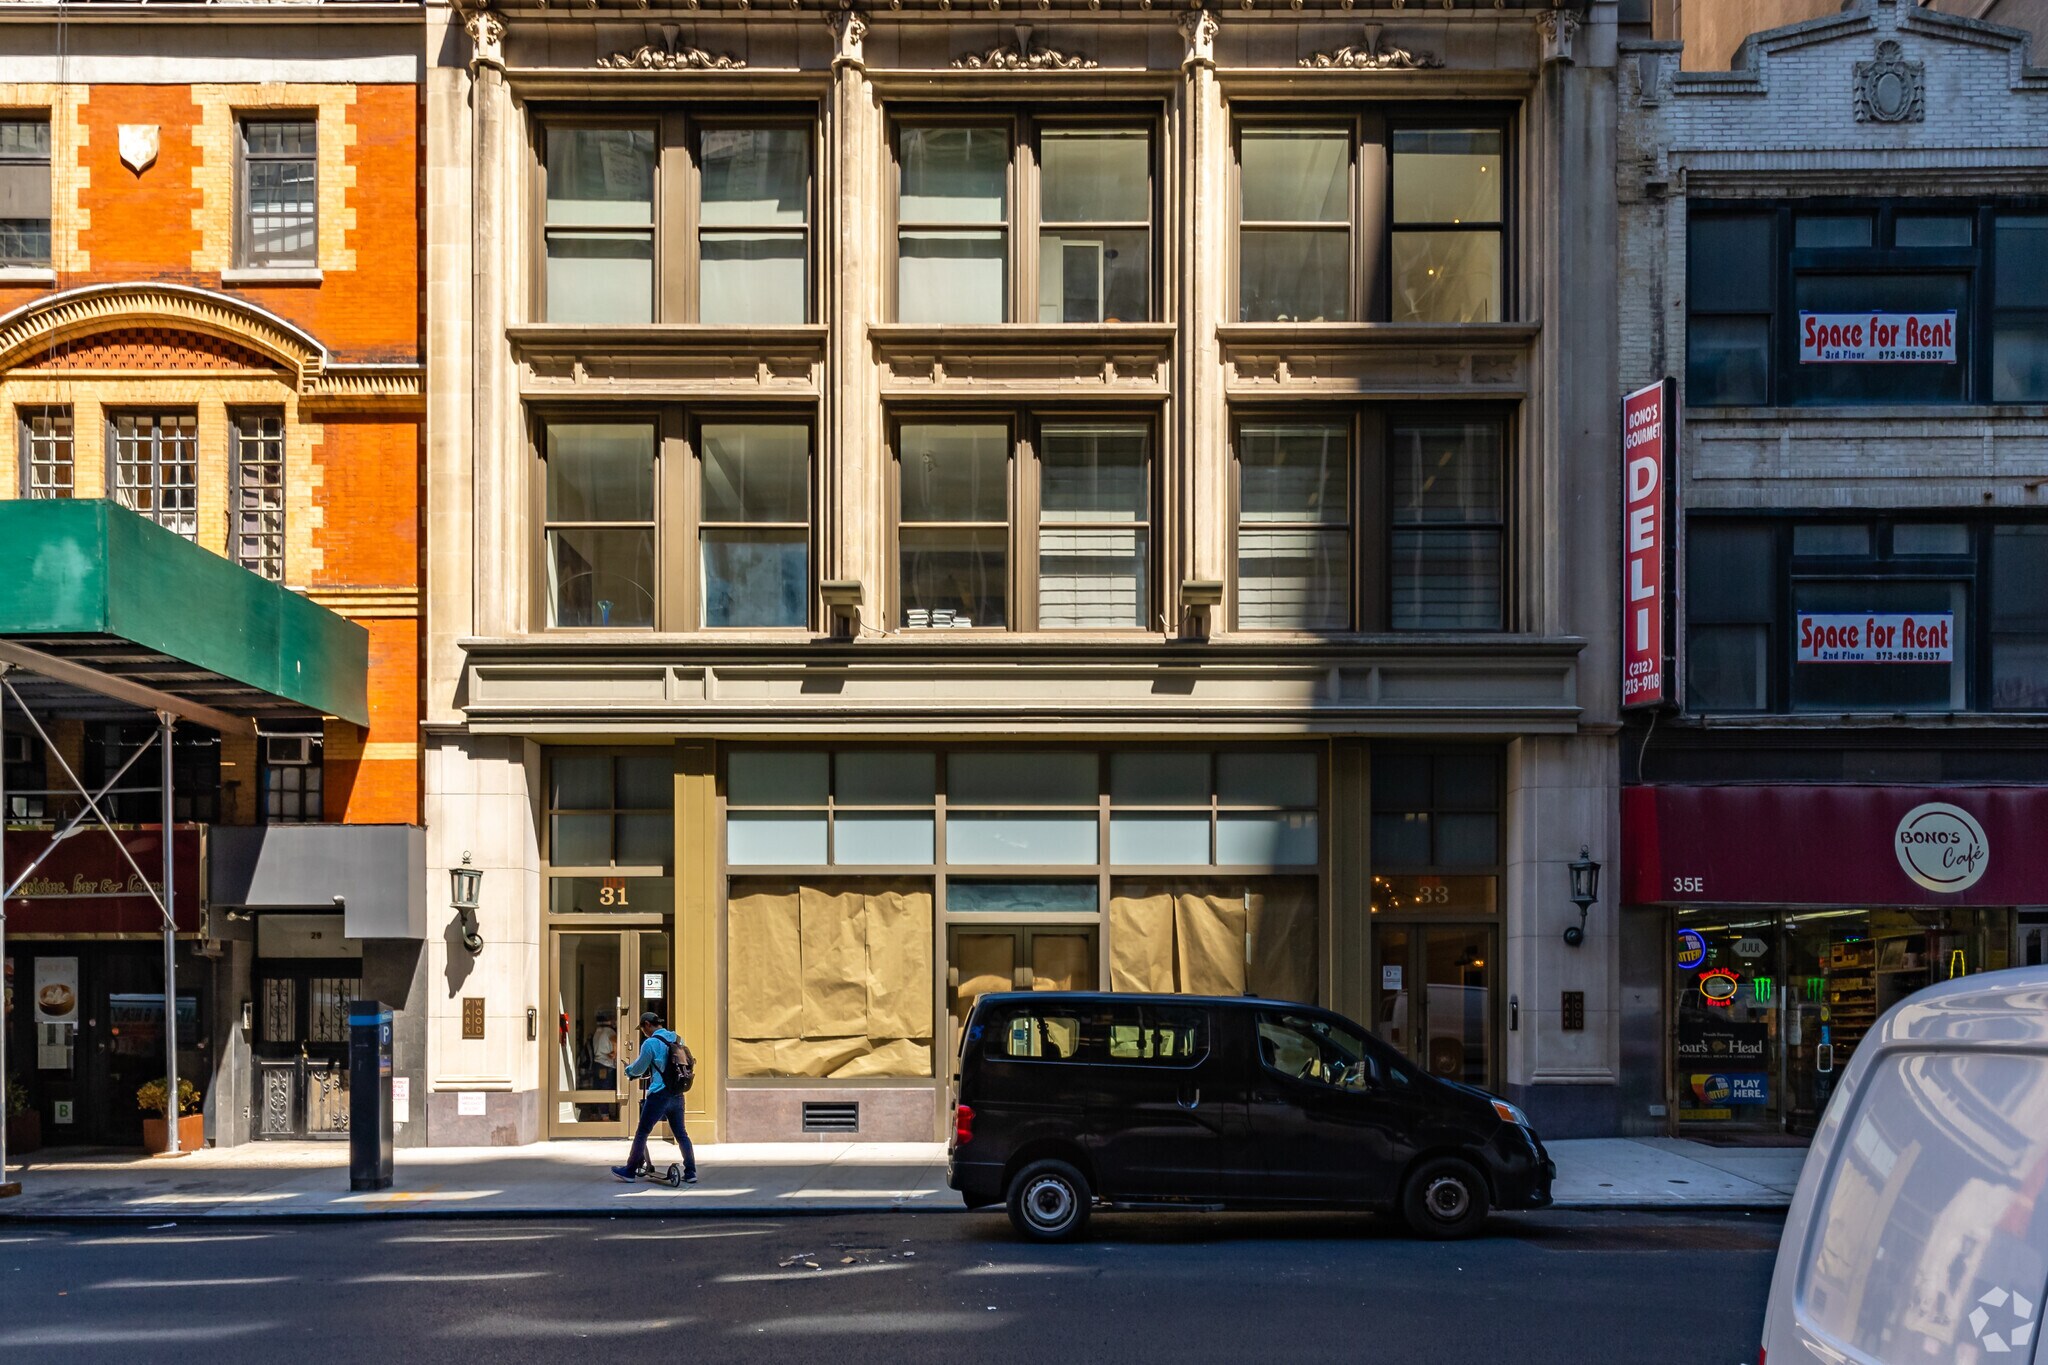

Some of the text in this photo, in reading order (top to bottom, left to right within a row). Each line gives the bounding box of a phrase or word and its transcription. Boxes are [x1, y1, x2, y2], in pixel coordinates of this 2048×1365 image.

[1805, 317, 1952, 356] Space for Rent
[1825, 351, 1943, 359] 3rd Floor 973-489-6937
[1629, 403, 1658, 430] BONO'S
[1626, 422, 1661, 449] GOURMET
[1629, 456, 1659, 651] DELI
[1801, 618, 1948, 657] Space for Rent
[1823, 652, 1941, 660] 2nd Floor 973-489-6937
[1629, 658, 1653, 677] (212)
[1625, 673, 1660, 696] 213-9118
[1900, 831, 1961, 845] BONO'S
[1942, 843, 1985, 873] Café
[1673, 877, 1704, 892] 35E
[600, 887, 629, 905] 31
[1419, 886, 1449, 904] 33
[475, 1000, 483, 1034] WOOD
[1574, 993, 1582, 1028] WOOD
[1729, 1040, 1763, 1054] Head
[1733, 1079, 1760, 1088] PLAY
[1733, 1089, 1765, 1098] HERE.
[59, 1104, 69, 1118] B
